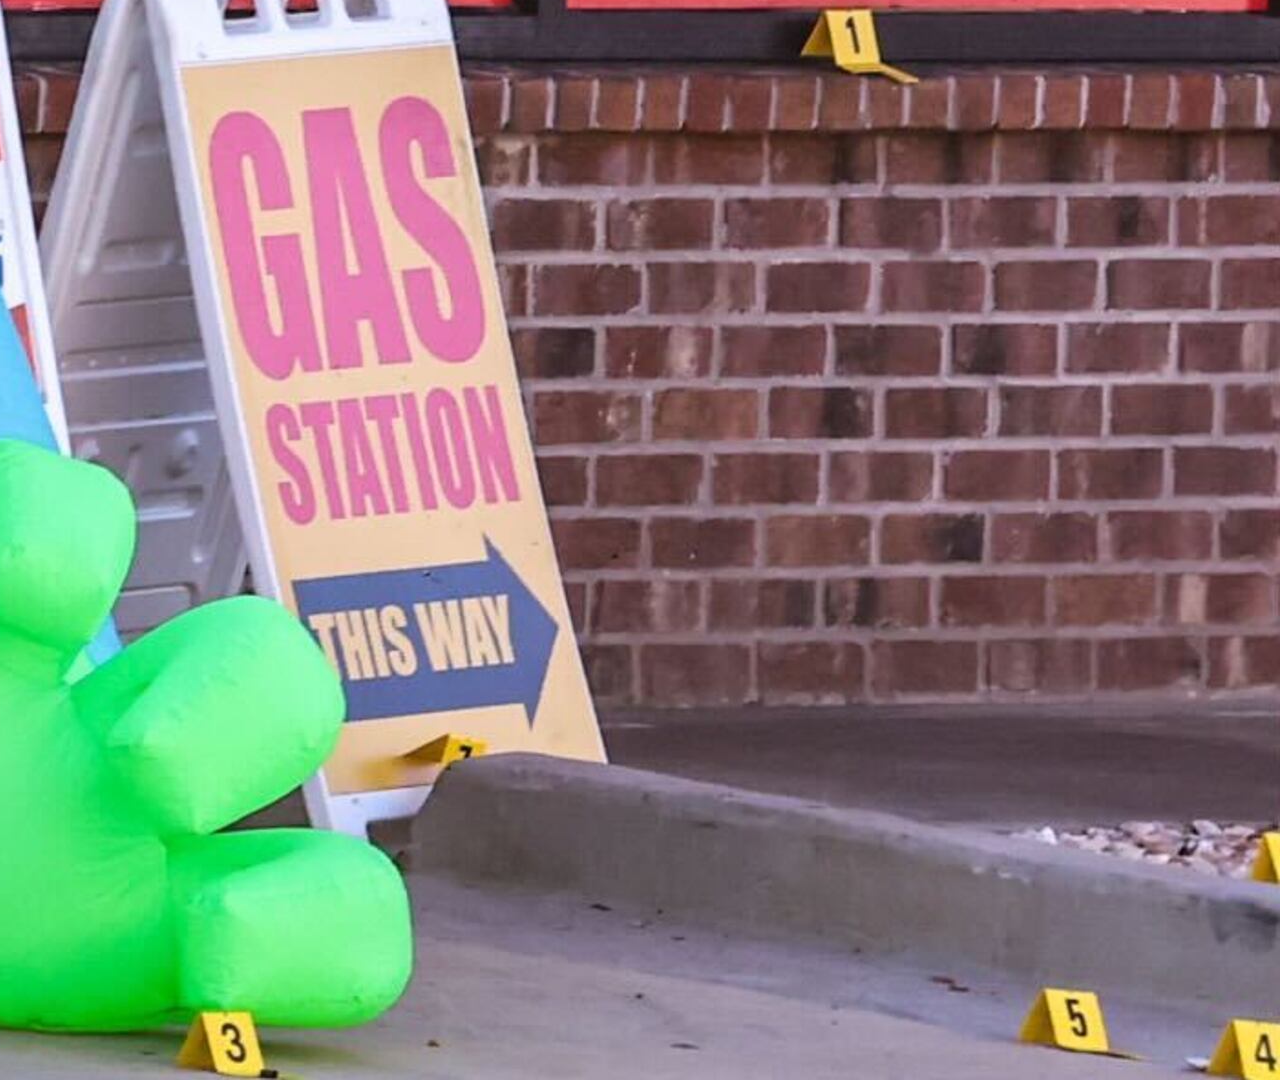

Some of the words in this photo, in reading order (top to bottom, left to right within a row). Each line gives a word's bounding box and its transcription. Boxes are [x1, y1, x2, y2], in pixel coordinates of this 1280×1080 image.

[844, 15, 862, 56] 1
[207, 94, 488, 382] GAS
[265, 383, 521, 526] STATION
[308, 604, 419, 682] THIS
[414, 593, 519, 672] WAY
[1064, 997, 1088, 1038] 5
[219, 1021, 247, 1063] 3
[1254, 1033, 1277, 1072] 4
